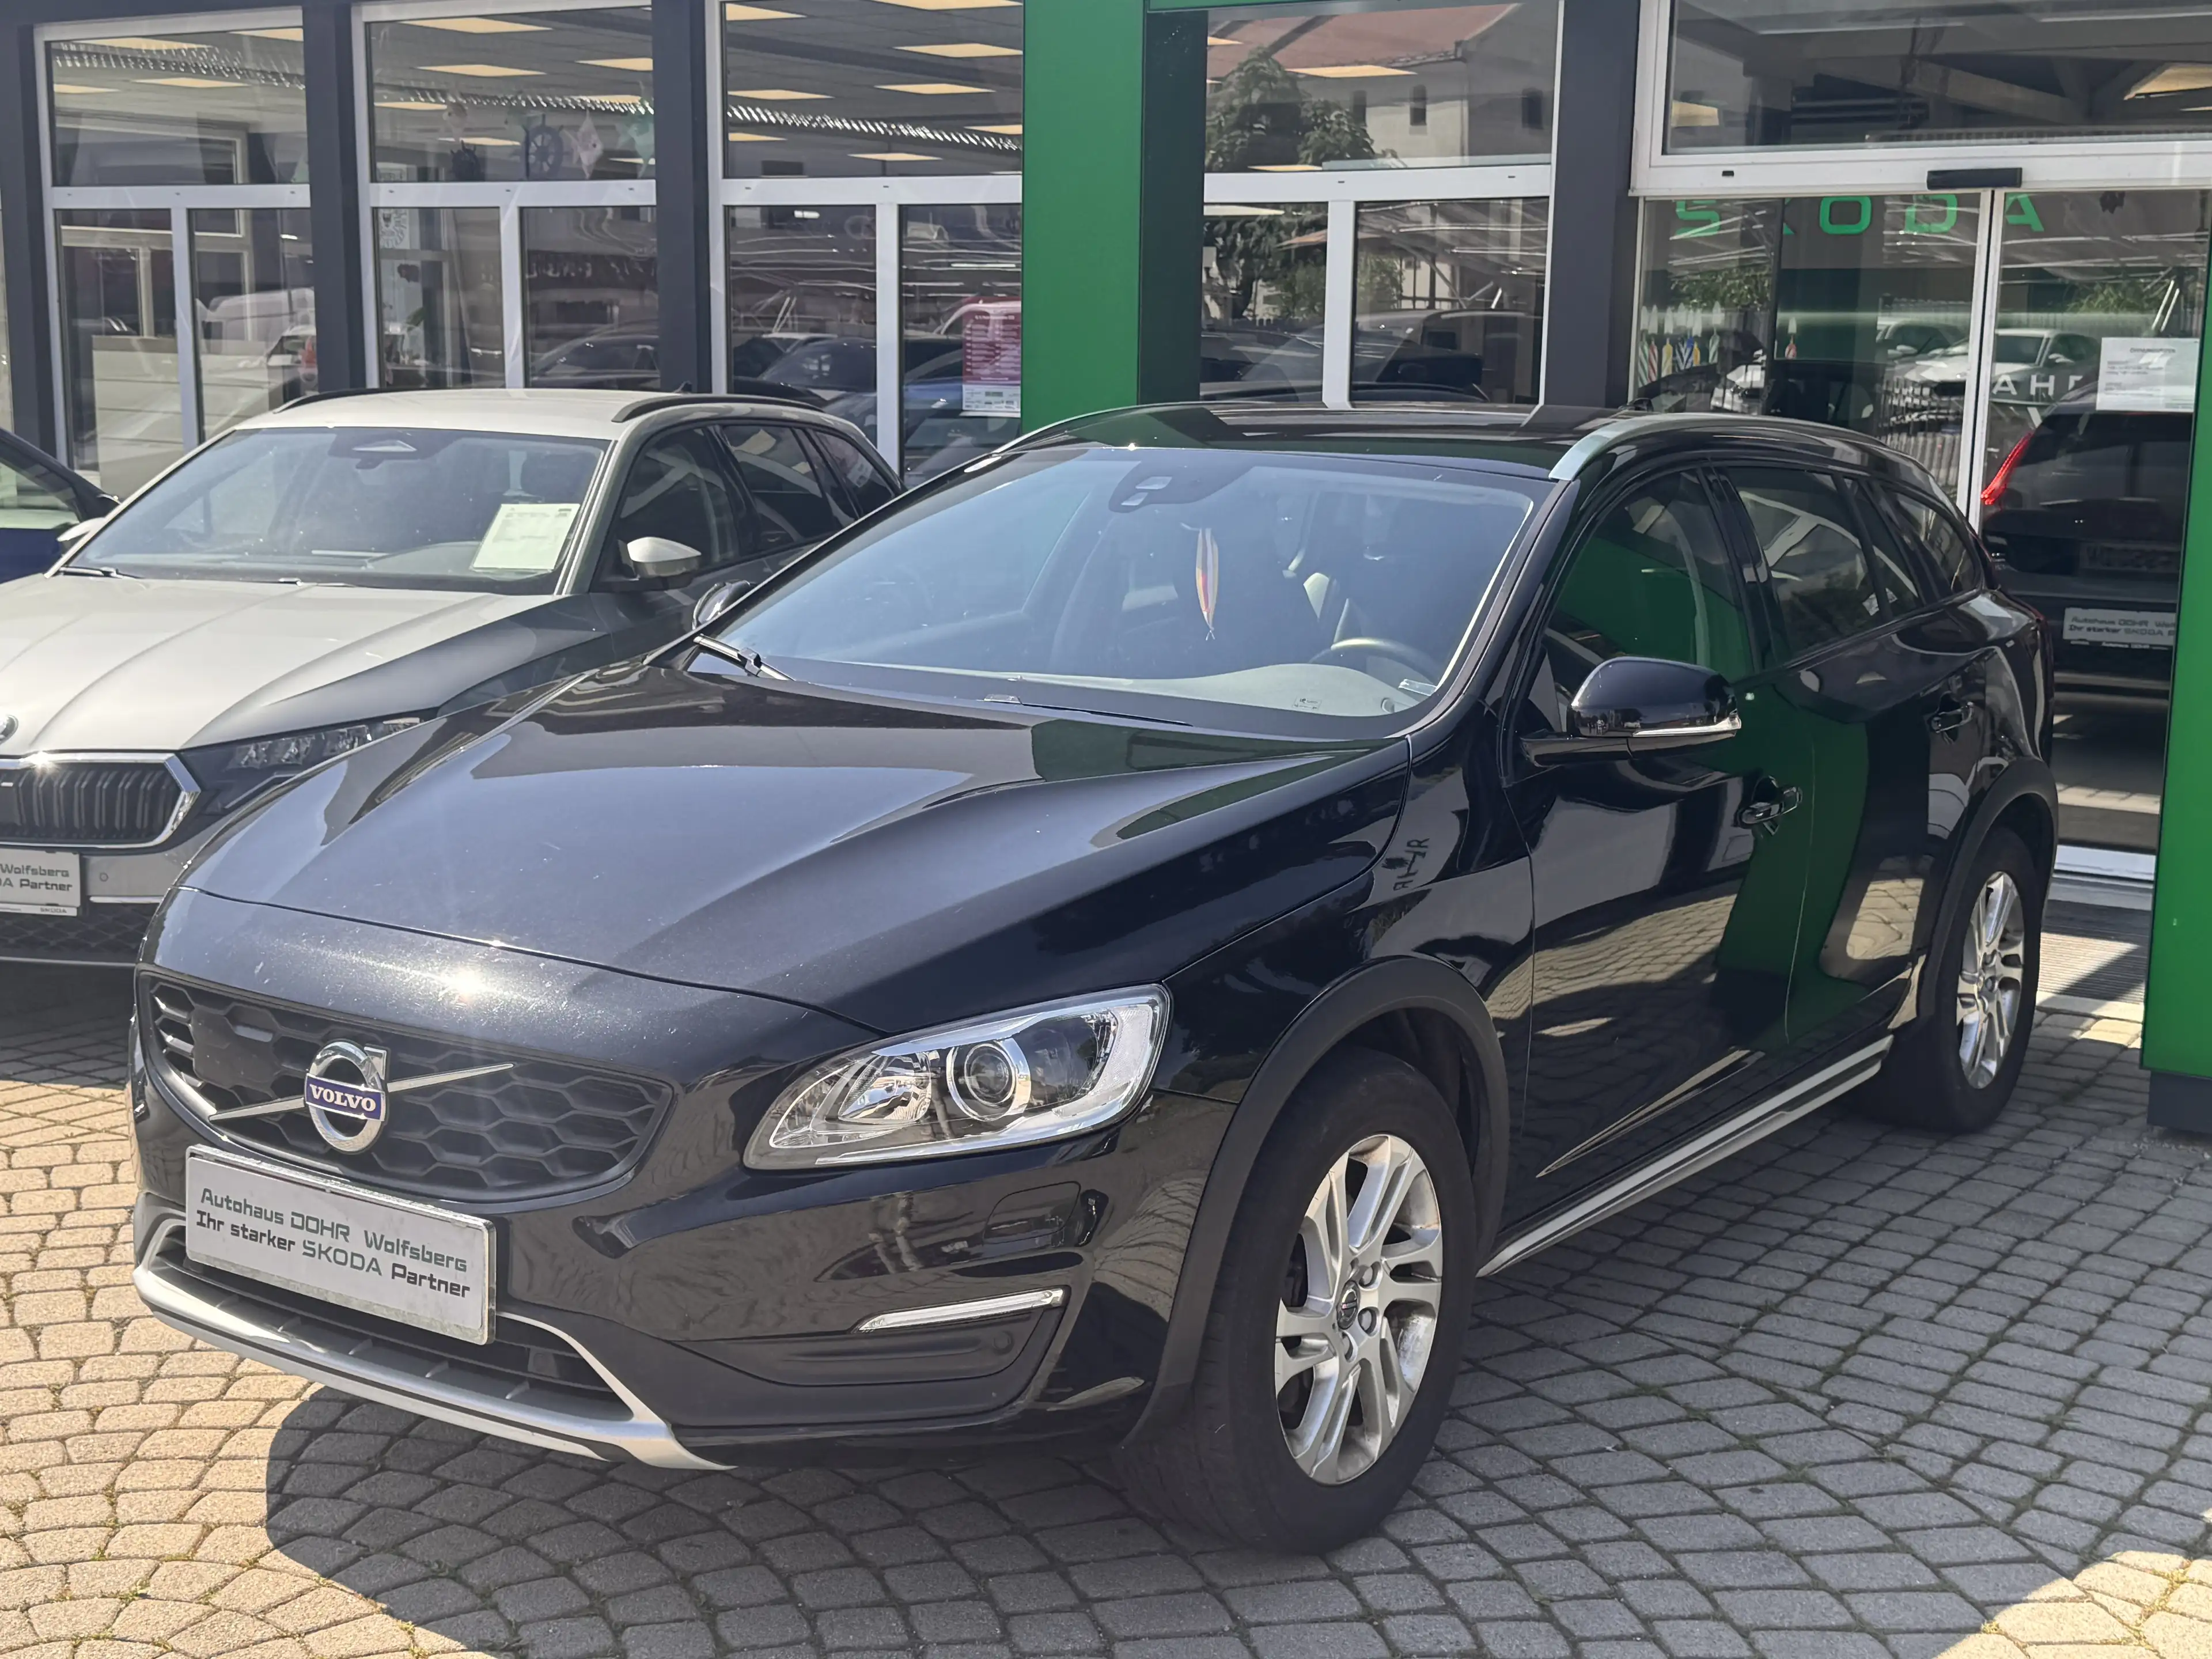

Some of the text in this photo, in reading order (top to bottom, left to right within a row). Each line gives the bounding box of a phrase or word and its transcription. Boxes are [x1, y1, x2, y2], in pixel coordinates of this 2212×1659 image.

[0, 863, 70, 877] Wolfsberg
[20, 878, 73, 891] Partner
[309, 1084, 376, 1112] VOLVO
[200, 1187, 467, 1272] Autohaus DOHR Wolfsberg
[196, 1210, 470, 1298] Ihr starker SKODA Partner
